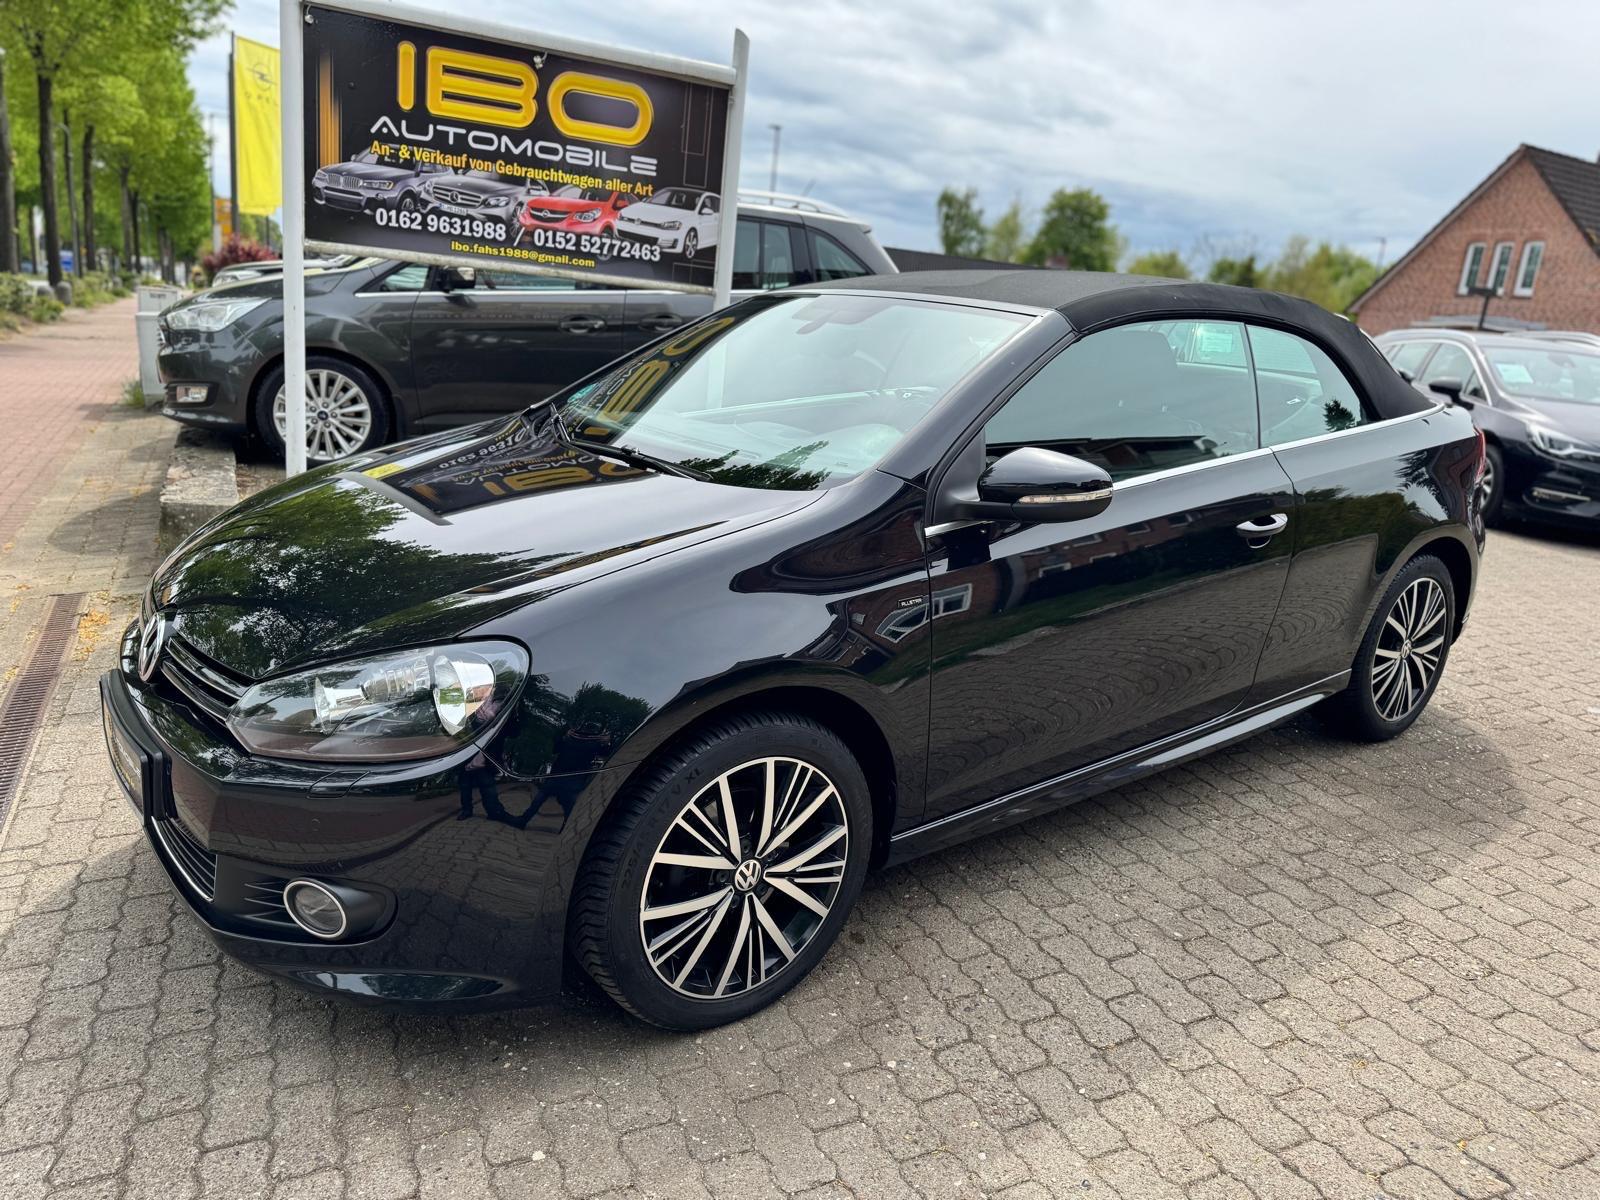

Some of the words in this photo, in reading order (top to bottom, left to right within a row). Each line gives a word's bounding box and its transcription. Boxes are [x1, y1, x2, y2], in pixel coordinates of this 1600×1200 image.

[397, 40, 655, 148] IBO
[370, 115, 658, 177] AUTOMOBILE
[370, 140, 396, 157] An-
[398, 144, 411, 160] &
[413, 147, 468, 168] Verkauf
[469, 157, 493, 172] von
[495, 160, 603, 190] Gebrauchtwagen
[605, 178, 633, 194] aller
[634, 182, 654, 197] Art
[375, 208, 422, 230] 0162
[427, 214, 506, 241] 9631988
[533, 228, 577, 250] 0152
[580, 236, 661, 262] 52772463
